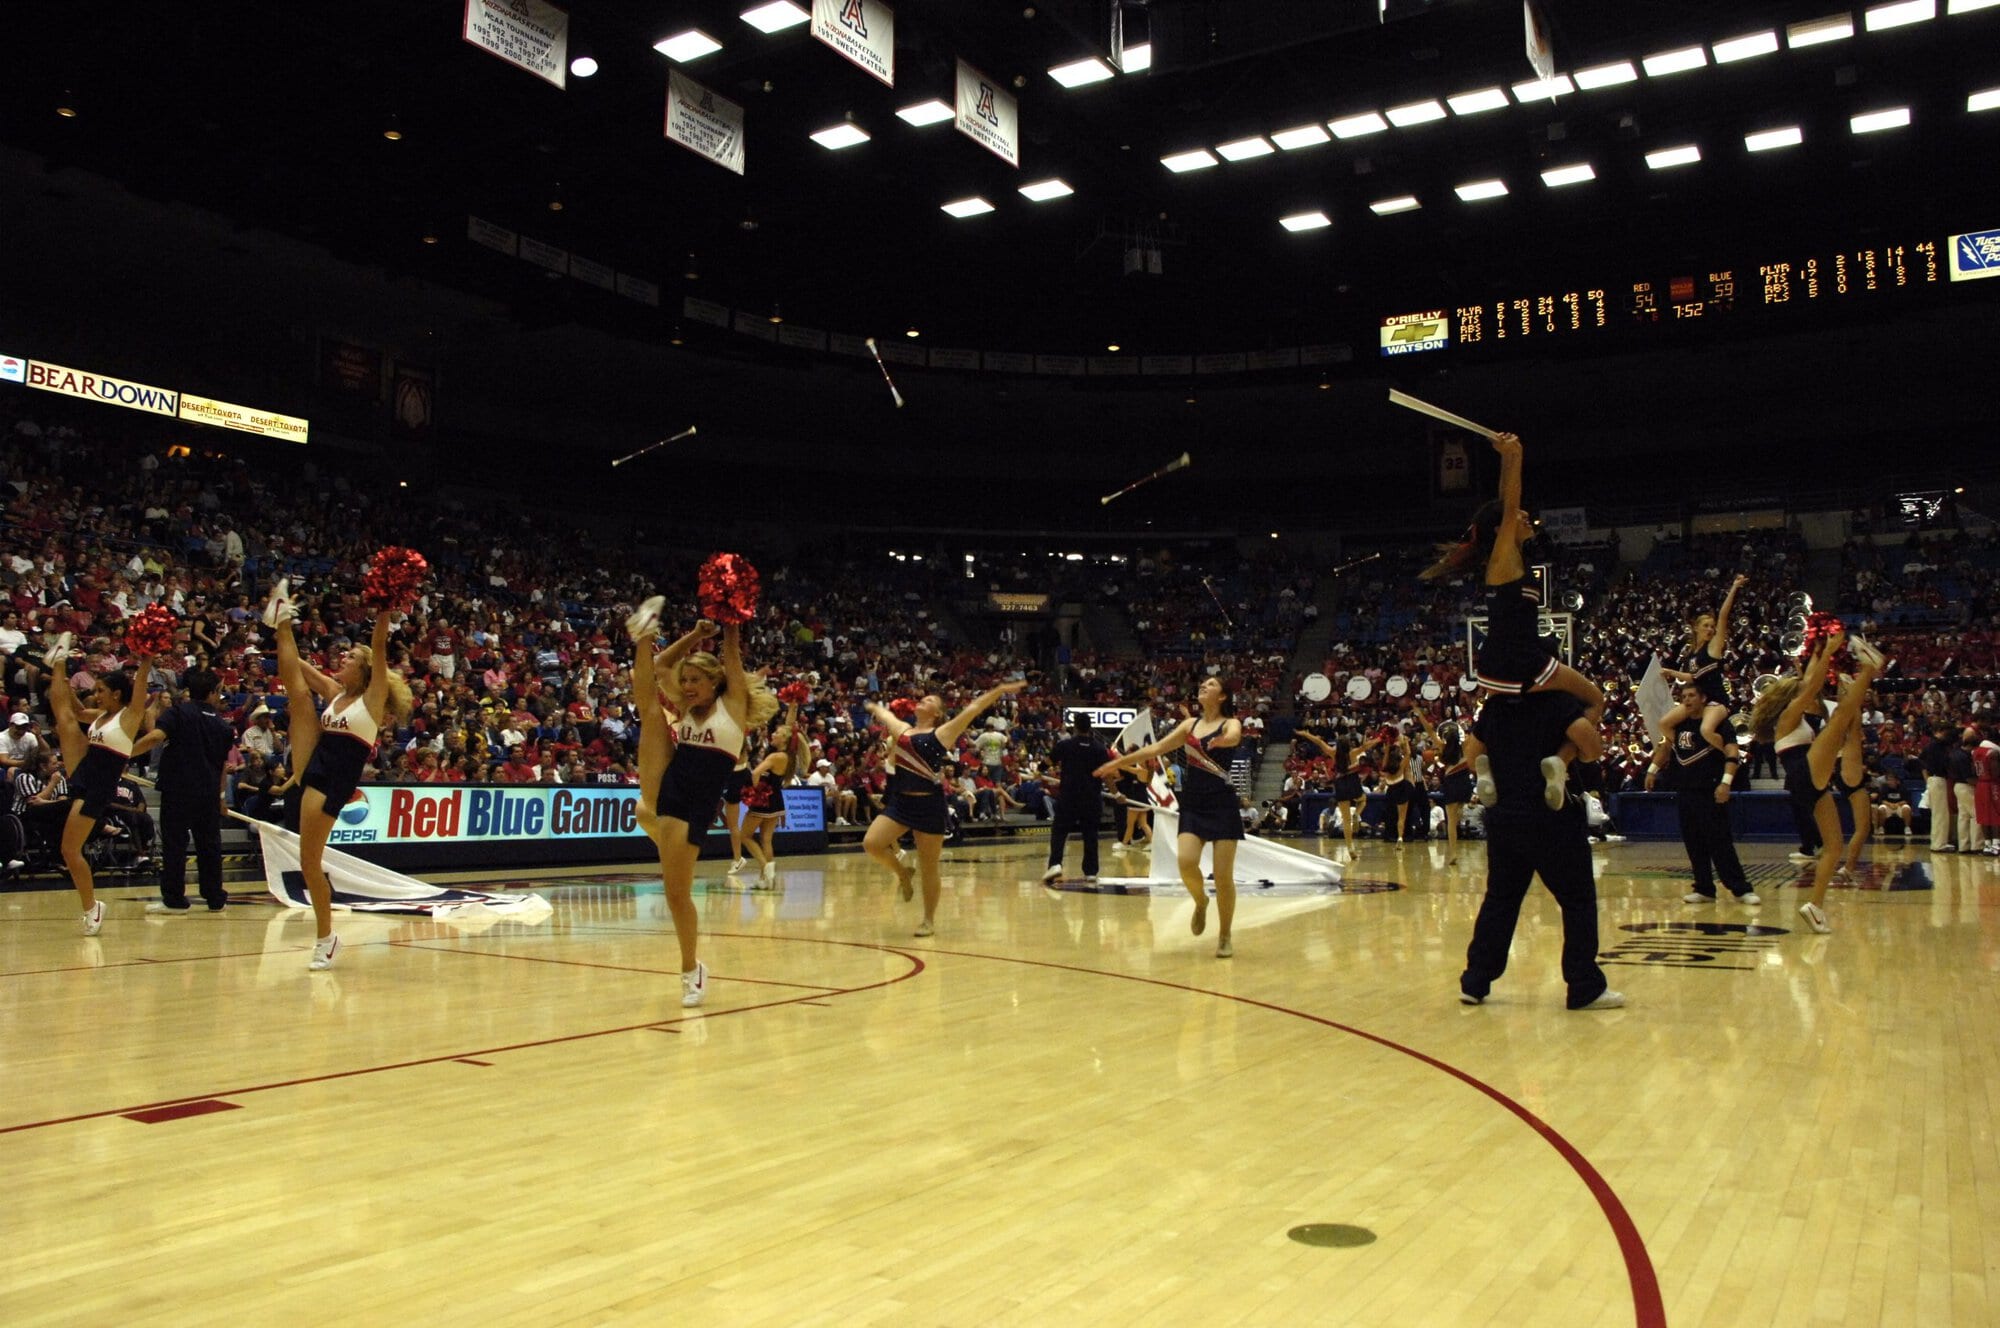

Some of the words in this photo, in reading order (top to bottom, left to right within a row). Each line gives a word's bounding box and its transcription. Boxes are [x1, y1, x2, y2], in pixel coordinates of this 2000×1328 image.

[484, 12, 504, 26] NCAA
[488, 23, 505, 37] 1992
[511, 35, 528, 48] 1993
[482, 37, 499, 49] 1999
[504, 48, 522, 60] 2000
[497, 36, 514, 49] 1996
[519, 47, 536, 59] 1997
[836, 38, 858, 56] SWEET
[860, 53, 887, 76] SIXTEEN
[976, 82, 998, 127] A
[974, 128, 990, 143] SWEET
[992, 140, 1014, 158] SIXTEEN
[1760, 263, 1789, 275] PLYR
[1808, 259, 1816, 268] 0
[1836, 255, 1845, 264] 2
[1858, 251, 1874, 261] 12
[1888, 246, 1904, 257] 14
[1916, 242, 1934, 252] 44
[1709, 271, 1732, 282] BLUE
[1766, 273, 1786, 284] PTS
[1801, 269, 1816, 279] 17
[1888, 256, 1901, 267] 11
[1633, 283, 1650, 292] RED
[1715, 283, 1733, 297] 59
[1765, 282, 1789, 294] RBS
[1808, 279, 1817, 288] 2
[1837, 275, 1846, 283] 0
[1765, 292, 1789, 304] FLS
[1809, 289, 1818, 298] 5
[1838, 284, 1846, 293] 0
[1927, 272, 1936, 281] 2
[1457, 306, 1482, 317] PLYR
[1497, 302, 1505, 312] 5
[1513, 299, 1529, 309] 20
[1538, 296, 1553, 306] 34
[1563, 293, 1579, 302] 42
[1588, 289, 1604, 300] 50
[1636, 293, 1653, 308] 54
[1672, 302, 1703, 318] 7:52
[1386, 311, 1441, 326] O'RIELLY
[1460, 324, 1480, 334] RBS
[1522, 317, 1529, 326] 2
[1571, 311, 1579, 320] 3
[1596, 308, 1605, 316] 2
[1461, 315, 1479, 325] PTS
[1497, 312, 1505, 320] 6
[1521, 308, 1529, 317] 2
[1571, 302, 1579, 310] 6
[1596, 299, 1604, 307] 4
[1498, 329, 1505, 338] 2
[1522, 327, 1530, 335] 3
[1547, 323, 1554, 332] 0
[1572, 320, 1579, 329] 3
[1597, 318, 1605, 326] 3
[1387, 340, 1443, 355] WATSON
[181, 400, 210, 414] DESERT
[213, 406, 242, 421] TOYOTA
[250, 415, 278, 428] DESERT
[280, 421, 308, 434] TOYOTA
[339, 716, 348, 729] A
[681, 726, 691, 740] U
[693, 732, 703, 742] of
[703, 728, 715, 743] A
[597, 773, 619, 784] POSS.
[387, 788, 462, 838] Red
[466, 790, 545, 837] Blue
[550, 789, 637, 835] Game
[330, 829, 377, 842] PEPSI
